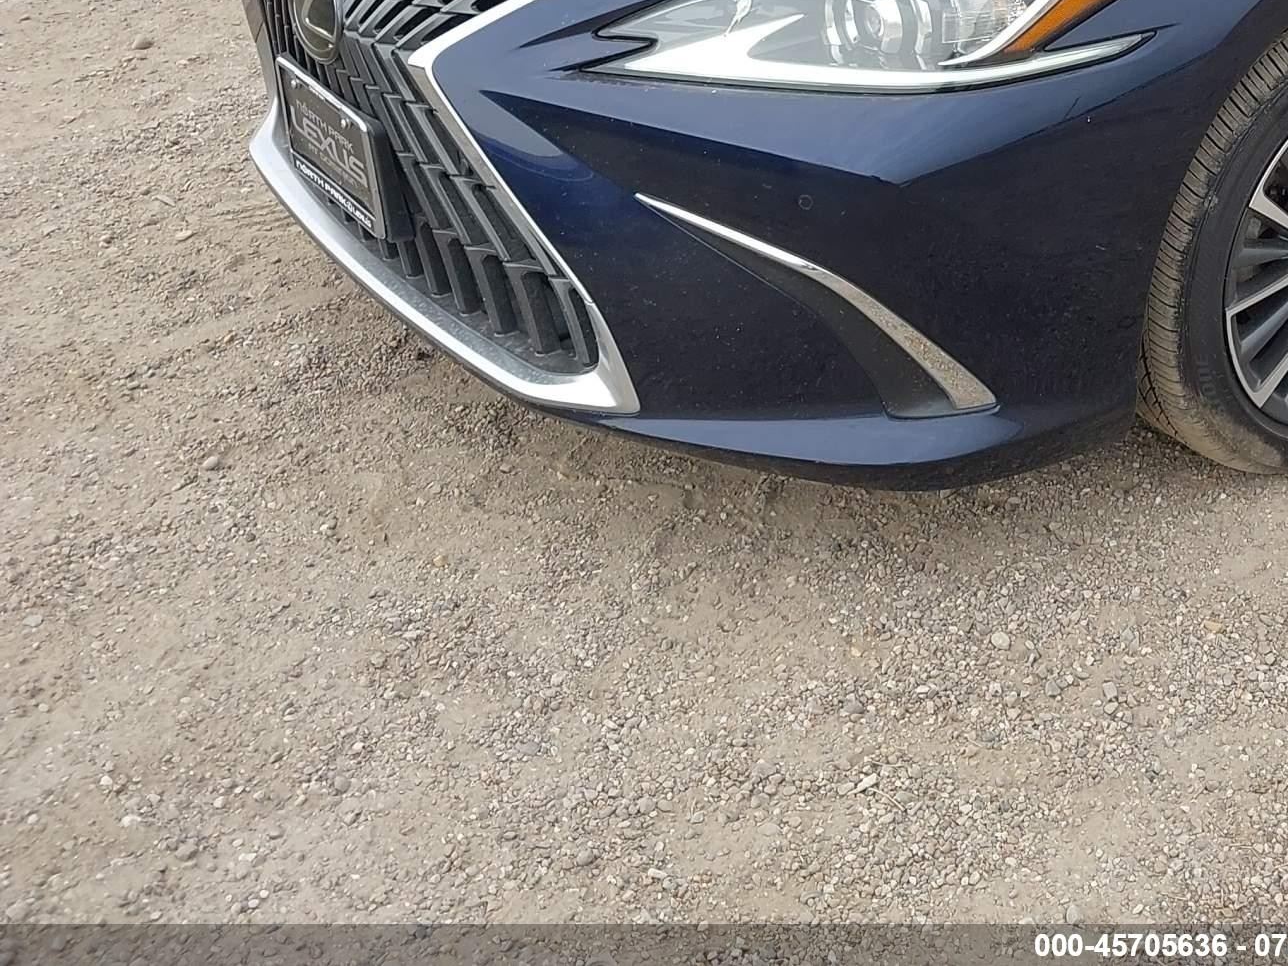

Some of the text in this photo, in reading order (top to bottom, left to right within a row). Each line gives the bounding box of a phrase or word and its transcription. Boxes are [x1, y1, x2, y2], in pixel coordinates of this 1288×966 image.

[290, 105, 368, 188] LEXUS
[328, 125, 354, 154] PARK
[324, 182, 346, 206] PARK
